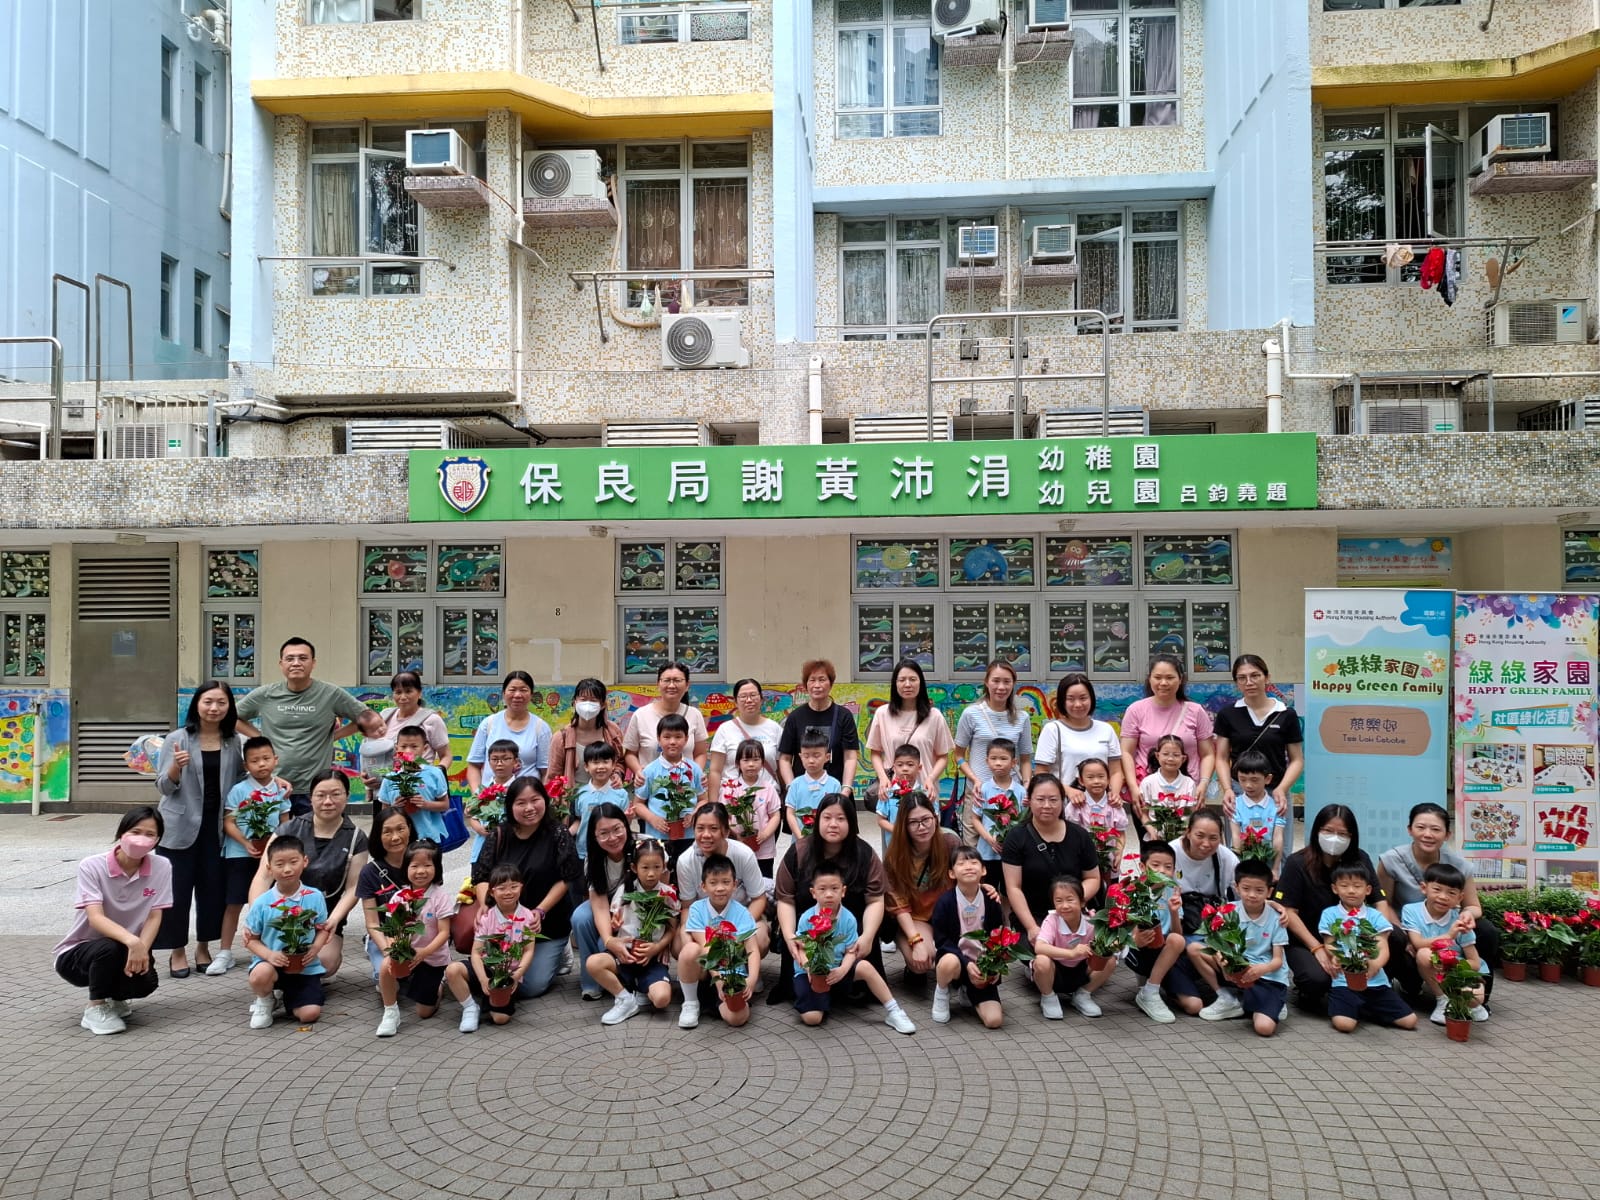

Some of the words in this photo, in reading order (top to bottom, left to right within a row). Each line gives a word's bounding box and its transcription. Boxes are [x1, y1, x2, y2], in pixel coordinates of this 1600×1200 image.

[1039, 443, 1160, 471] 幼稚園
[520, 455, 1009, 505] 保良局謝黃沛涓
[1039, 478, 1160, 505] 幼兒園
[1180, 482, 1288, 503] 呂鈞堯題
[555, 608, 561, 616] 8
[1337, 654, 1420, 679] 綠綠家園
[1468, 660, 1590, 685] 綠綠家園
[1312, 680, 1352, 693] Happy
[1356, 680, 1398, 691] Green
[1402, 682, 1443, 695] Family
[1468, 686, 1507, 694] HAPPY
[1510, 687, 1549, 695] GREEN
[1552, 687, 1593, 696] FAMILY
[1494, 708, 1570, 725] 社區綠化活動
